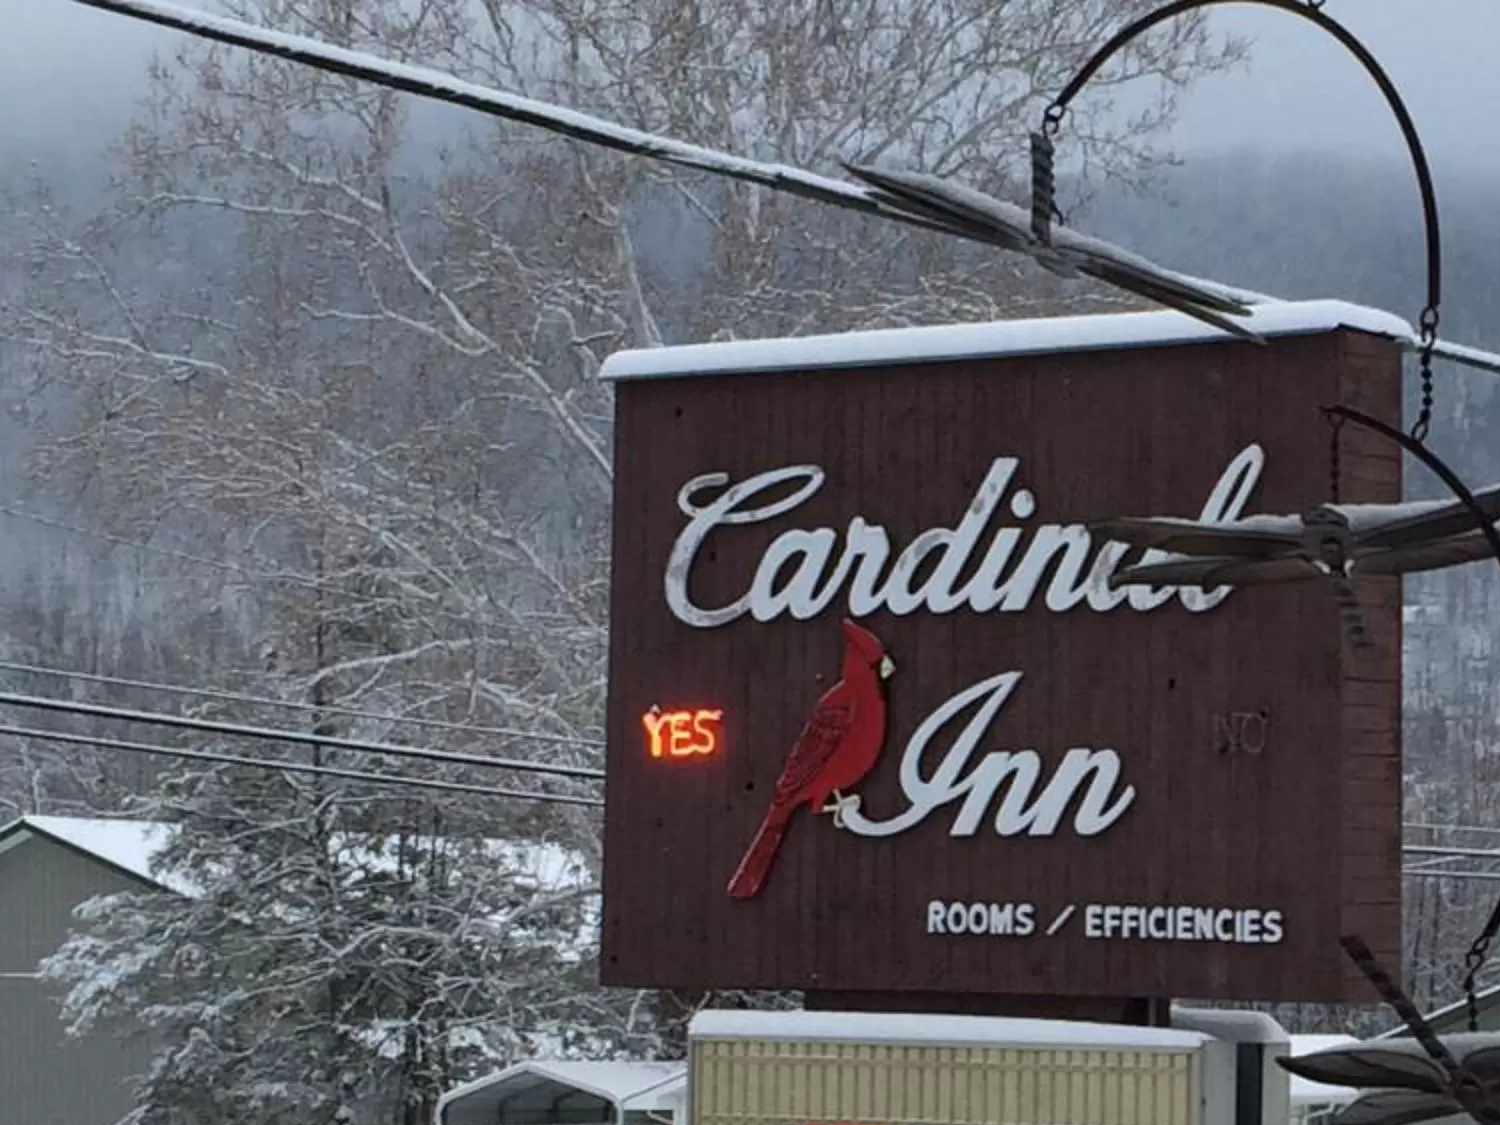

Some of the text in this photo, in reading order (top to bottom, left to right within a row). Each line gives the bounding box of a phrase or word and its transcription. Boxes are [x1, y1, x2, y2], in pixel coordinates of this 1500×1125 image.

[643, 704, 724, 758] YES
[838, 670, 1137, 837] Inn
[1212, 706, 1270, 754] NO
[926, 900, 1035, 936] ROOMS
[1085, 904, 1284, 943] EFFICIENCIES
